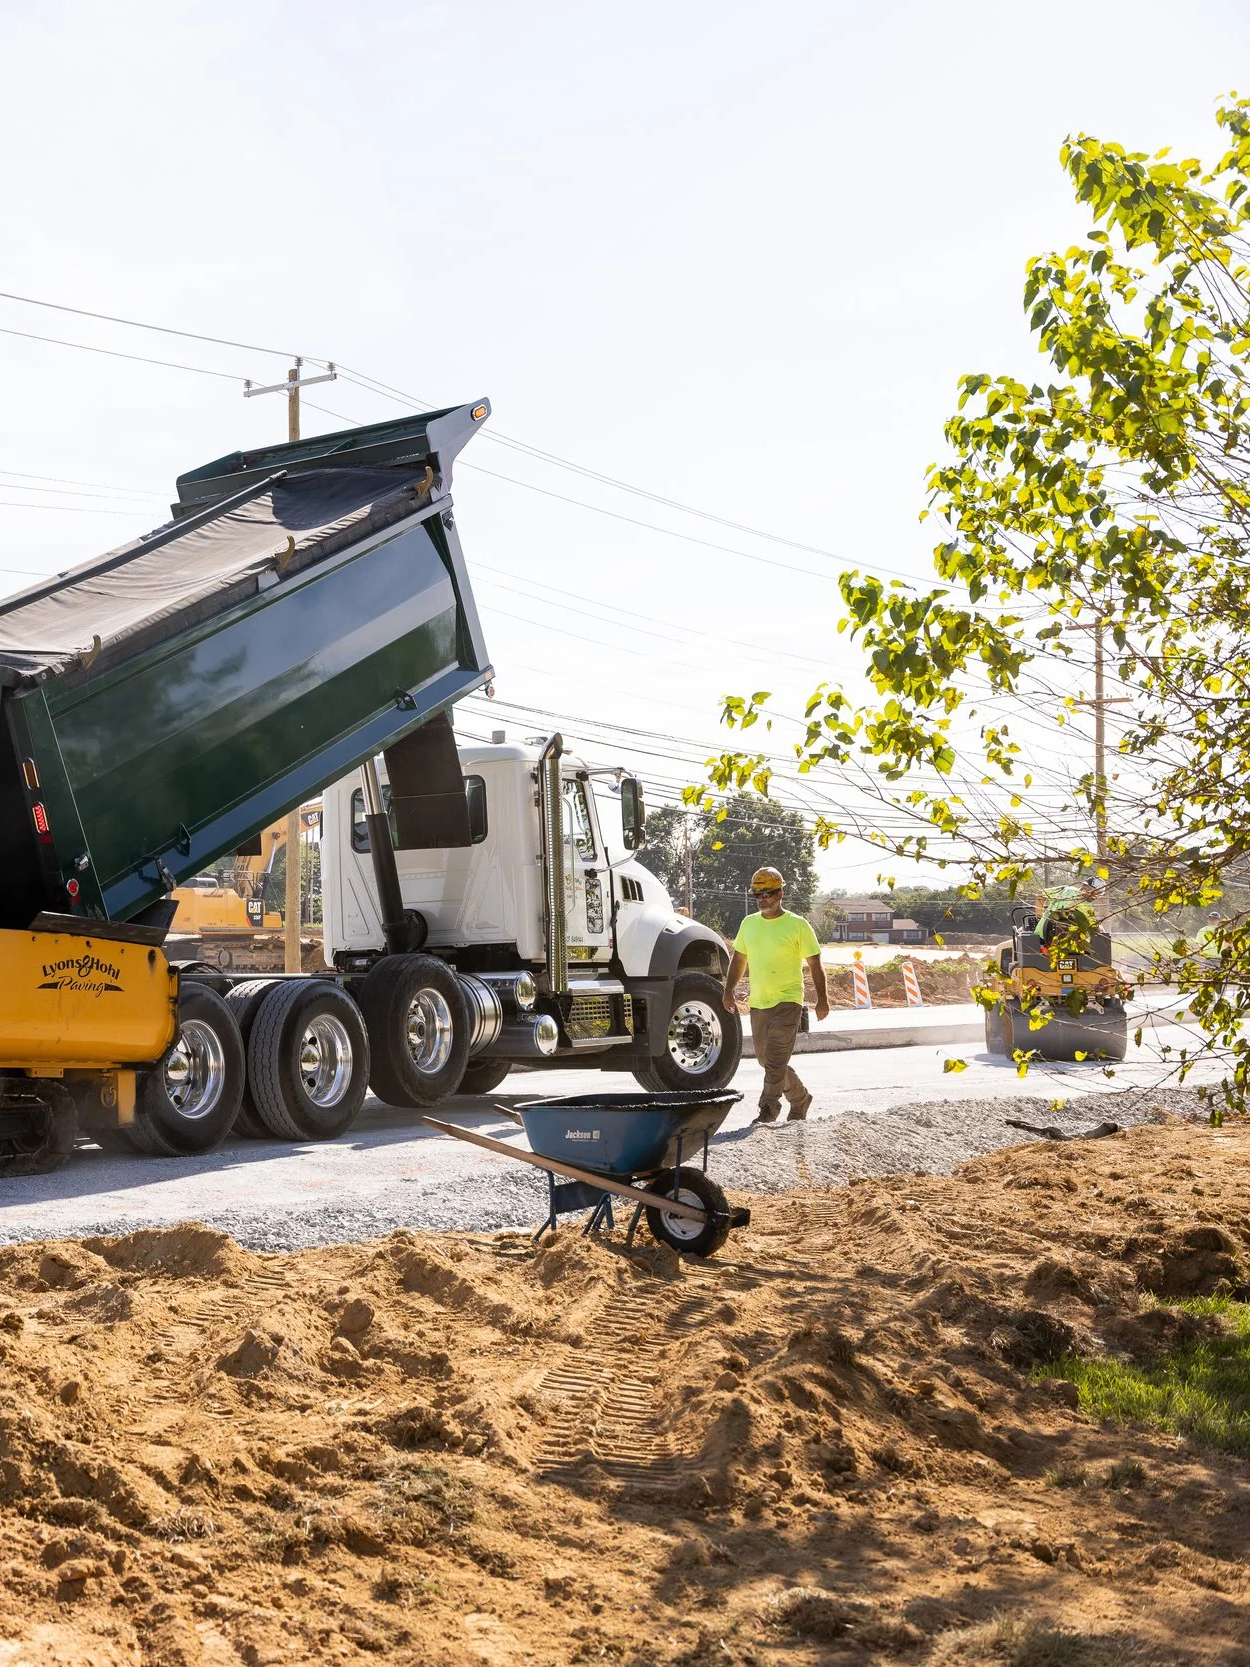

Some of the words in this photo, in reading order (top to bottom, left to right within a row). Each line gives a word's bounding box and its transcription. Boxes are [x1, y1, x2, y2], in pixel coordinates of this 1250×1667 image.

[248, 901, 261, 914] CAT
[42, 959, 81, 977] Lyons
[91, 957, 120, 980] Hohl
[58, 976, 104, 997] Paving
[565, 1129, 591, 1139] Jackson
